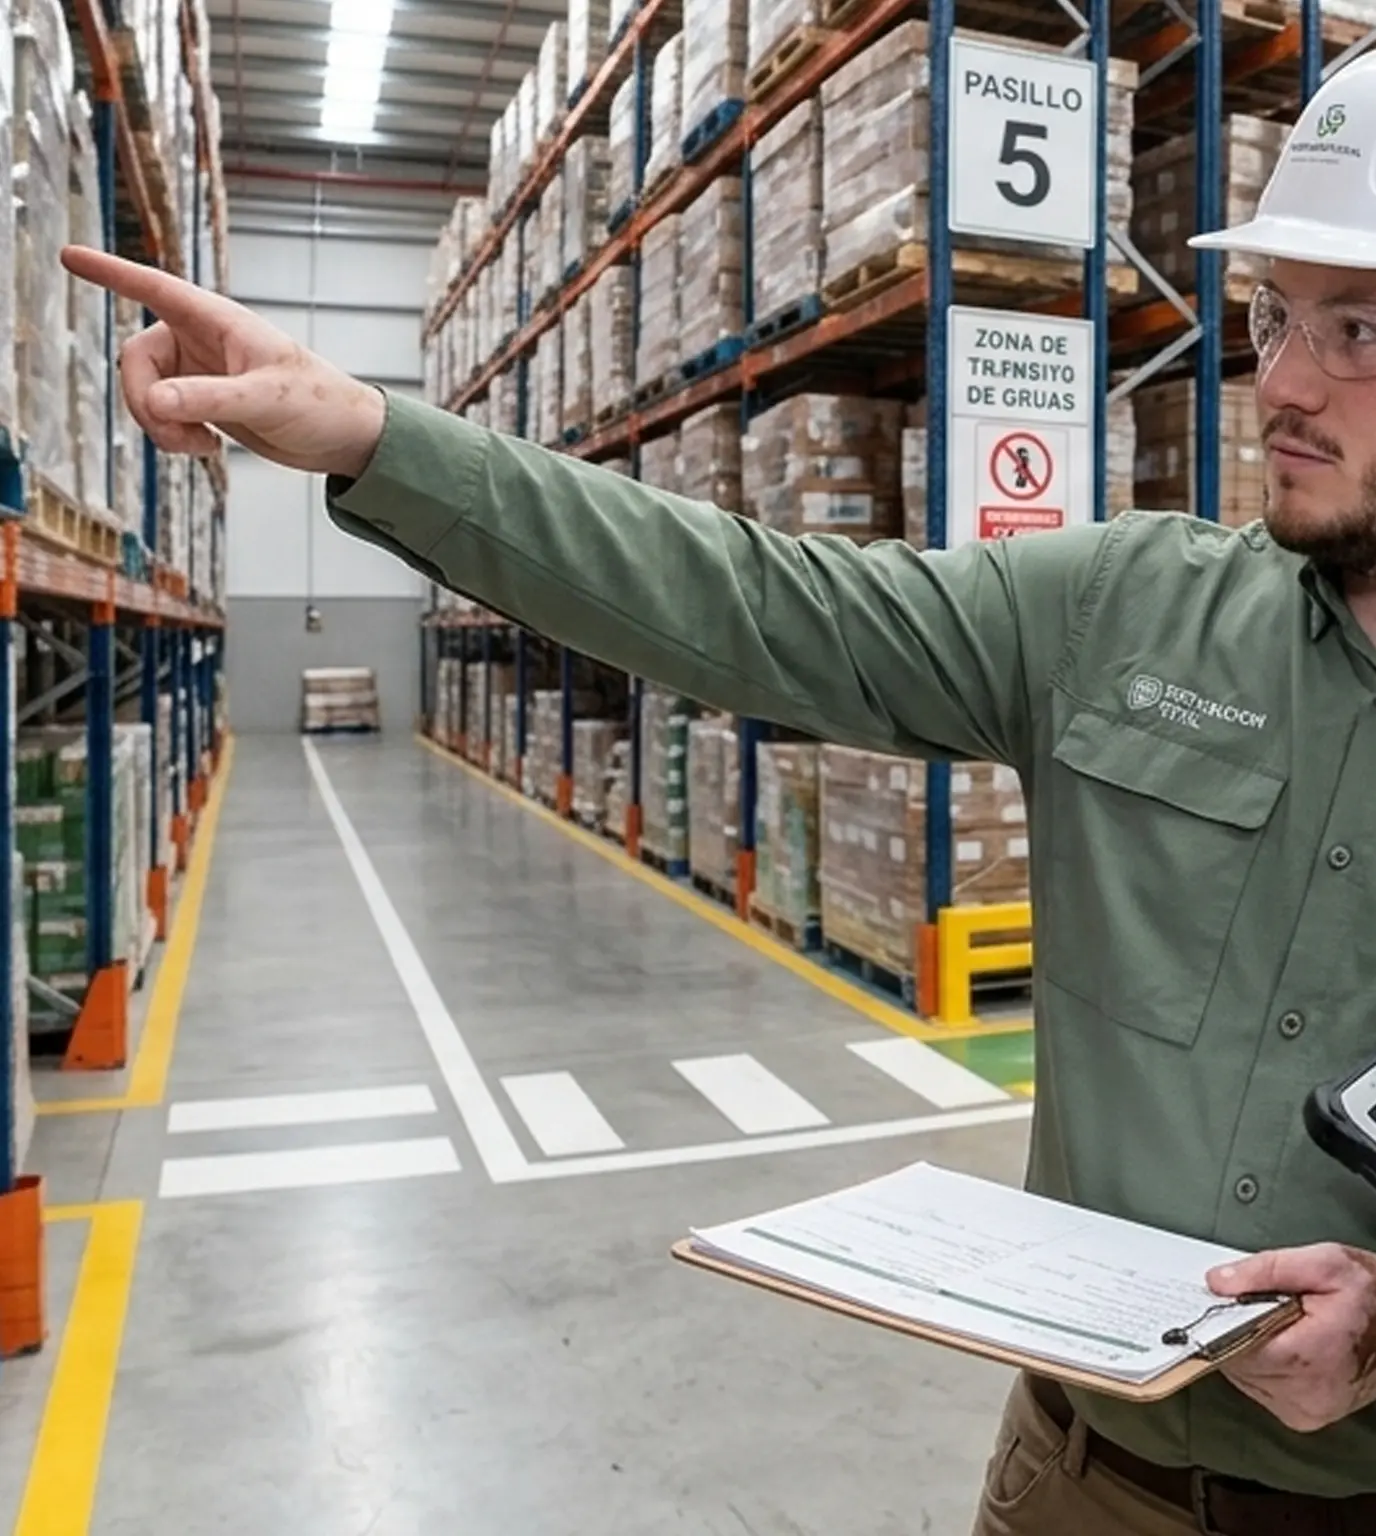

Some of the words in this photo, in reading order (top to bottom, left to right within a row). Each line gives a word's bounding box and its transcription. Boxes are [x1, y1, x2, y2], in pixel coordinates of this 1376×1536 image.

[965, 70, 1082, 112] PASILLO
[995, 119, 1051, 208] 5
[975, 328, 1034, 352] ZONA
[1041, 335, 1067, 355] DE
[967, 385, 995, 405] DE
[1002, 388, 1075, 411] GRUAS
